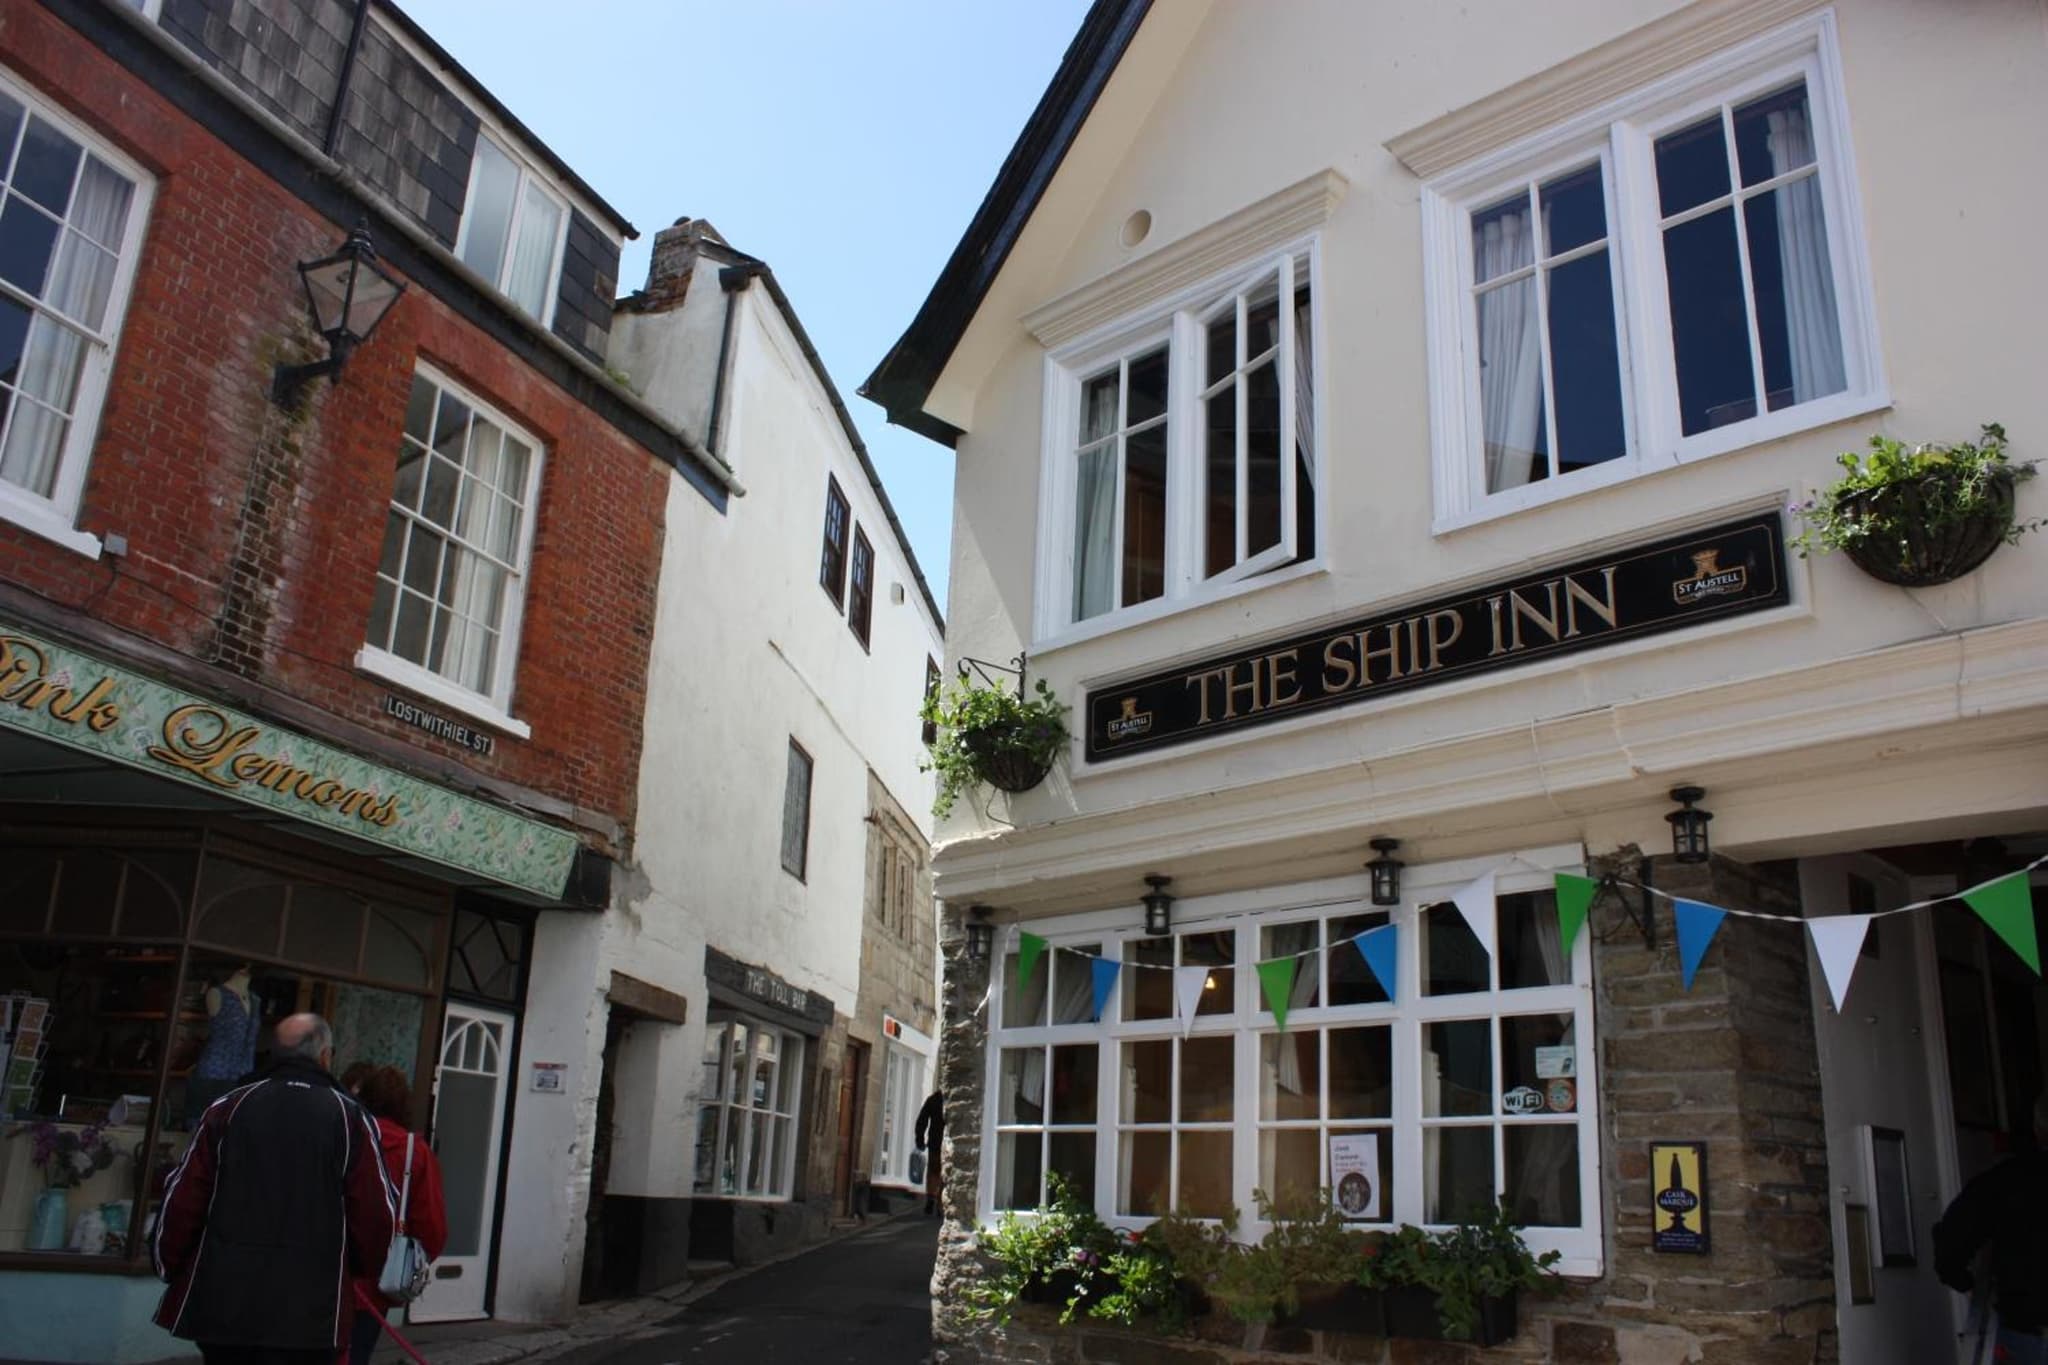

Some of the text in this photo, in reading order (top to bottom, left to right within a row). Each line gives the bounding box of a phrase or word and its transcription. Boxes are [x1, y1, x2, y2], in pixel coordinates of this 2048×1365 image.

[1678, 583, 1692, 594] ST
[1694, 572, 1739, 591] AUSTELL
[1186, 566, 1618, 725] THE SHIP INN
[387, 697, 490, 753] LOSTWITHIEL ST
[147, 703, 398, 827] Lemons
[747, 971, 766, 996] THE
